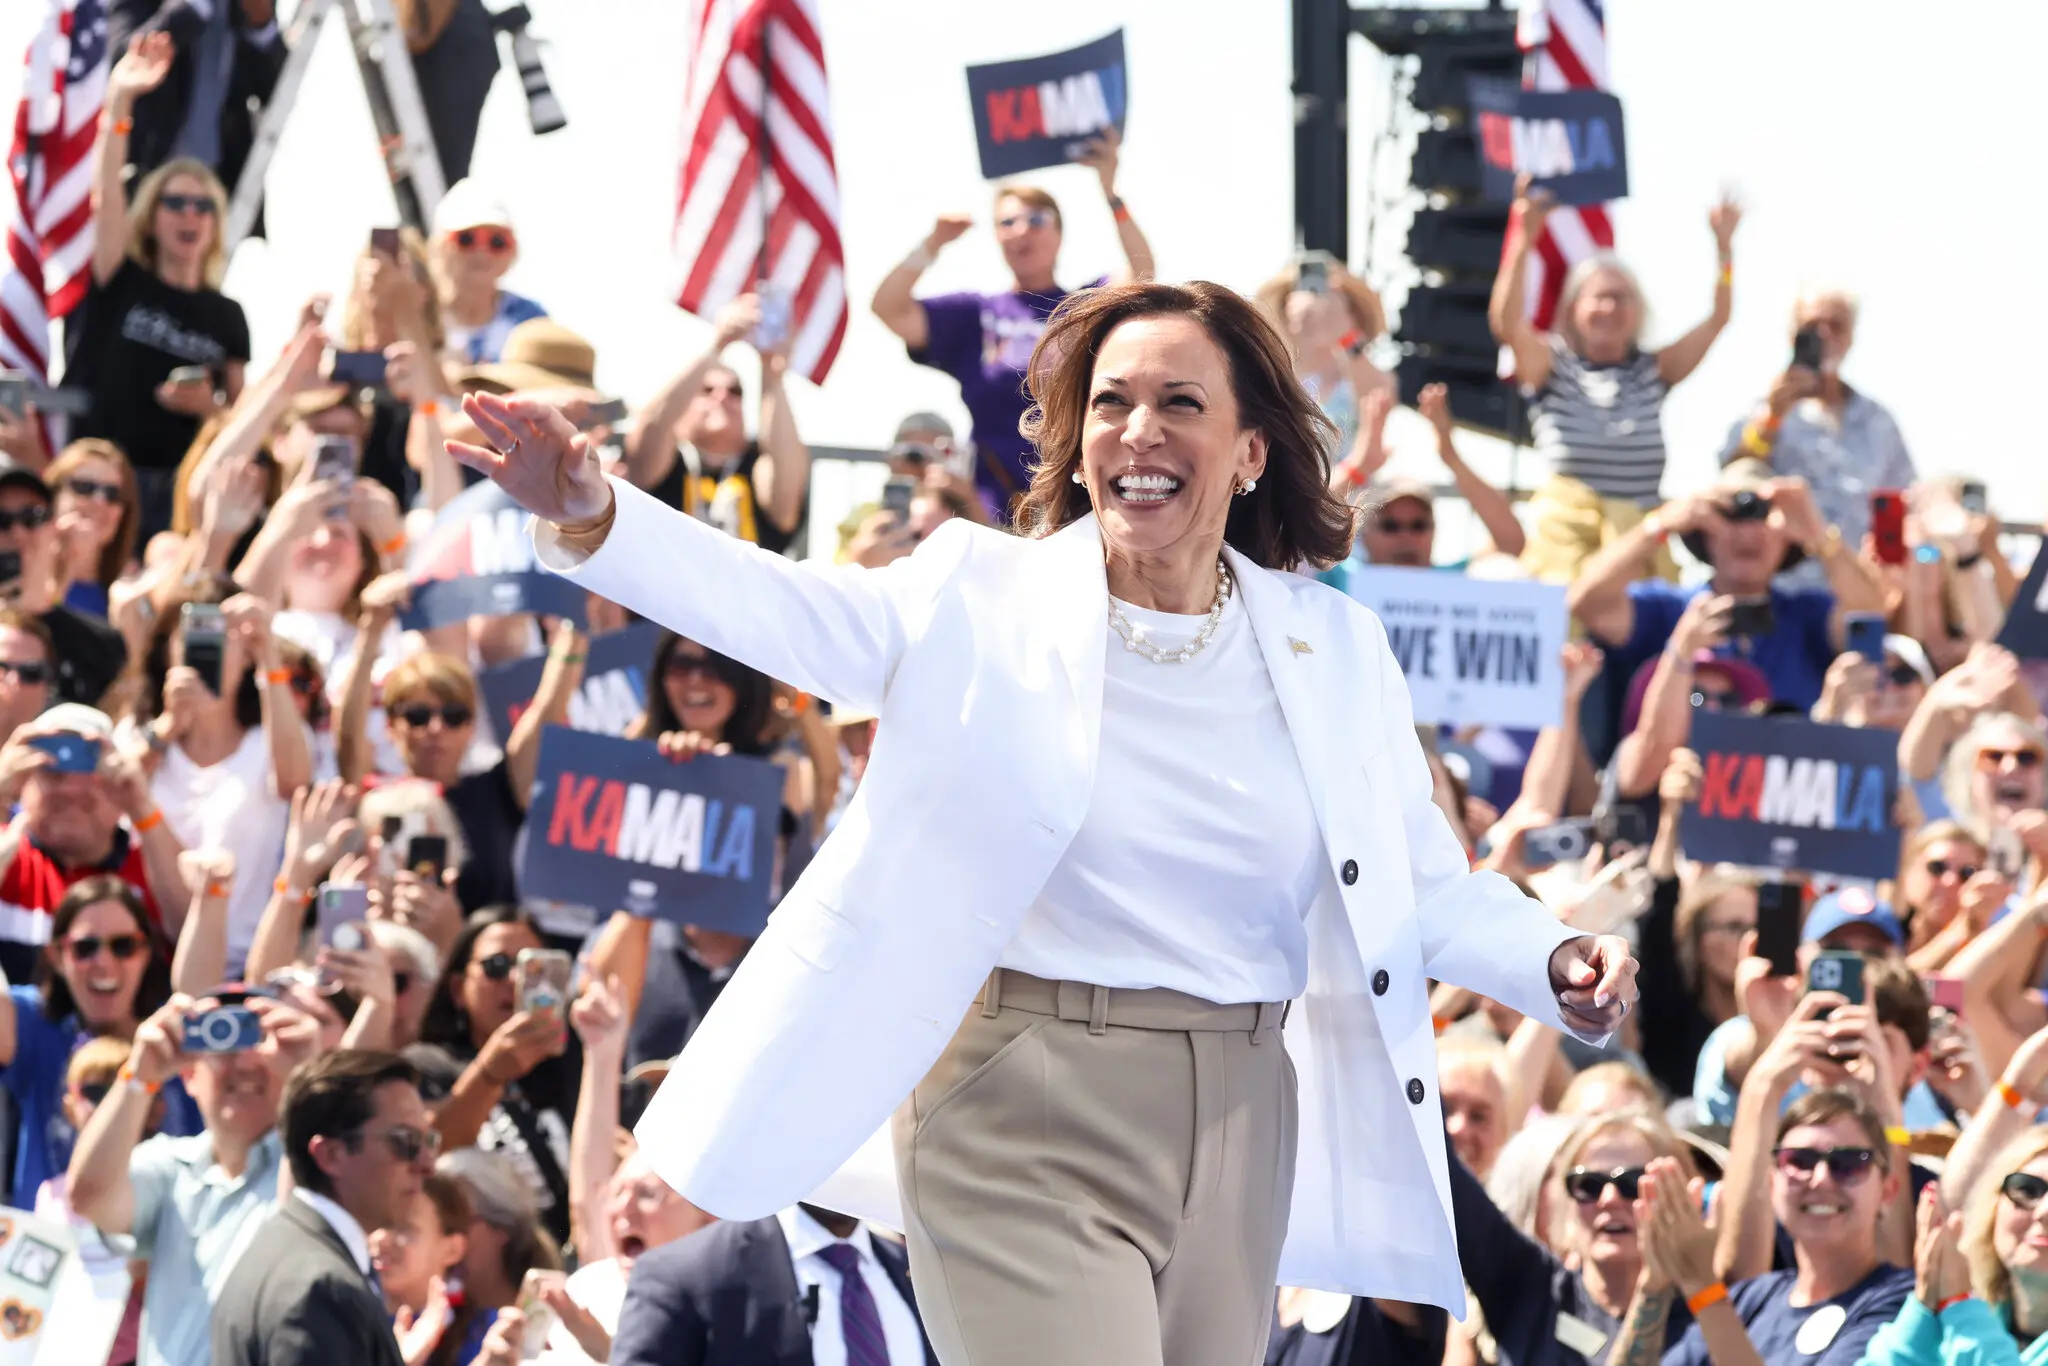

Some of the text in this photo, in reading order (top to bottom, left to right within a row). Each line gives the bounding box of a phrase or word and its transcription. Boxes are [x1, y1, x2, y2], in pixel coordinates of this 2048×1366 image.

[1453, 625, 1540, 687] WIN
[547, 771, 756, 881] KAMALA
[1698, 752, 1885, 835] KAMALA
